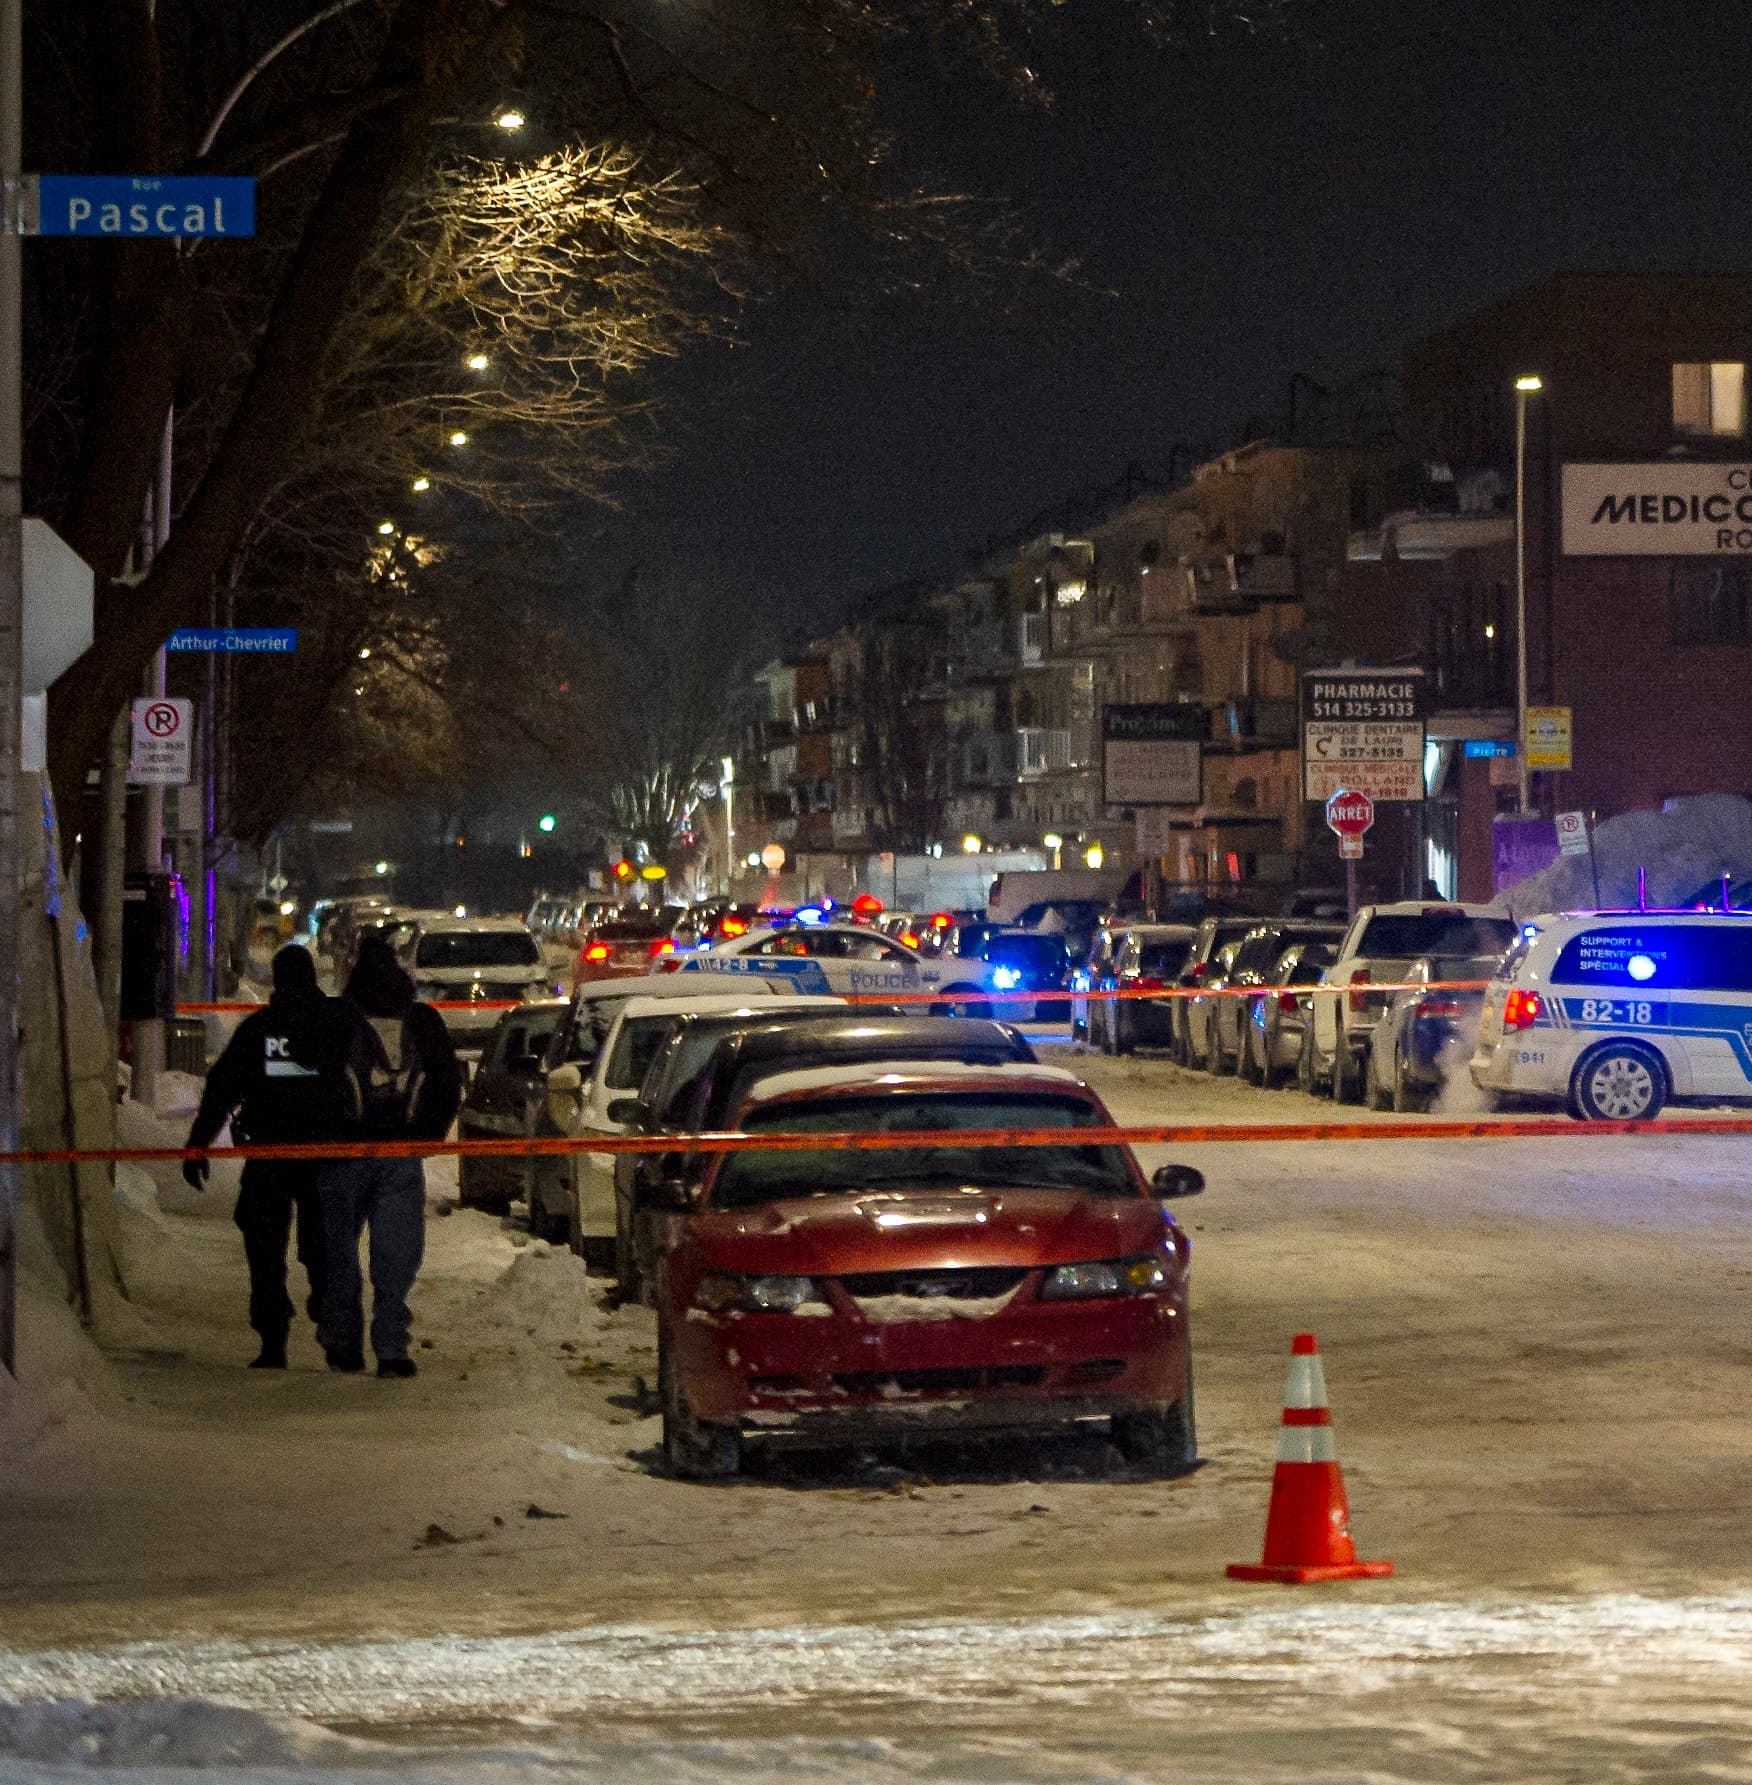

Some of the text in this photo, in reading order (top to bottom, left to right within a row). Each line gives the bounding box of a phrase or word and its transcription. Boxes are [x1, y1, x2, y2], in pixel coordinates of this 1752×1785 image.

[132, 178, 162, 191] Rue
[68, 197, 226, 233] Pascal
[170, 636, 290, 651] Arthur-Chevrier
[1313, 683, 1415, 699] PHARMACIE
[1313, 702, 1415, 717] 514 325-3133
[1308, 724, 1419, 735] CLINIQUE DENTAIRE
[1473, 746, 1508, 757] Pierre
[1340, 775, 1415, 786] ROLLAND
[1580, 936, 1632, 947] SUPPORT
[850, 971, 912, 989] POLICE
[1581, 999, 1652, 1024] 82-18
